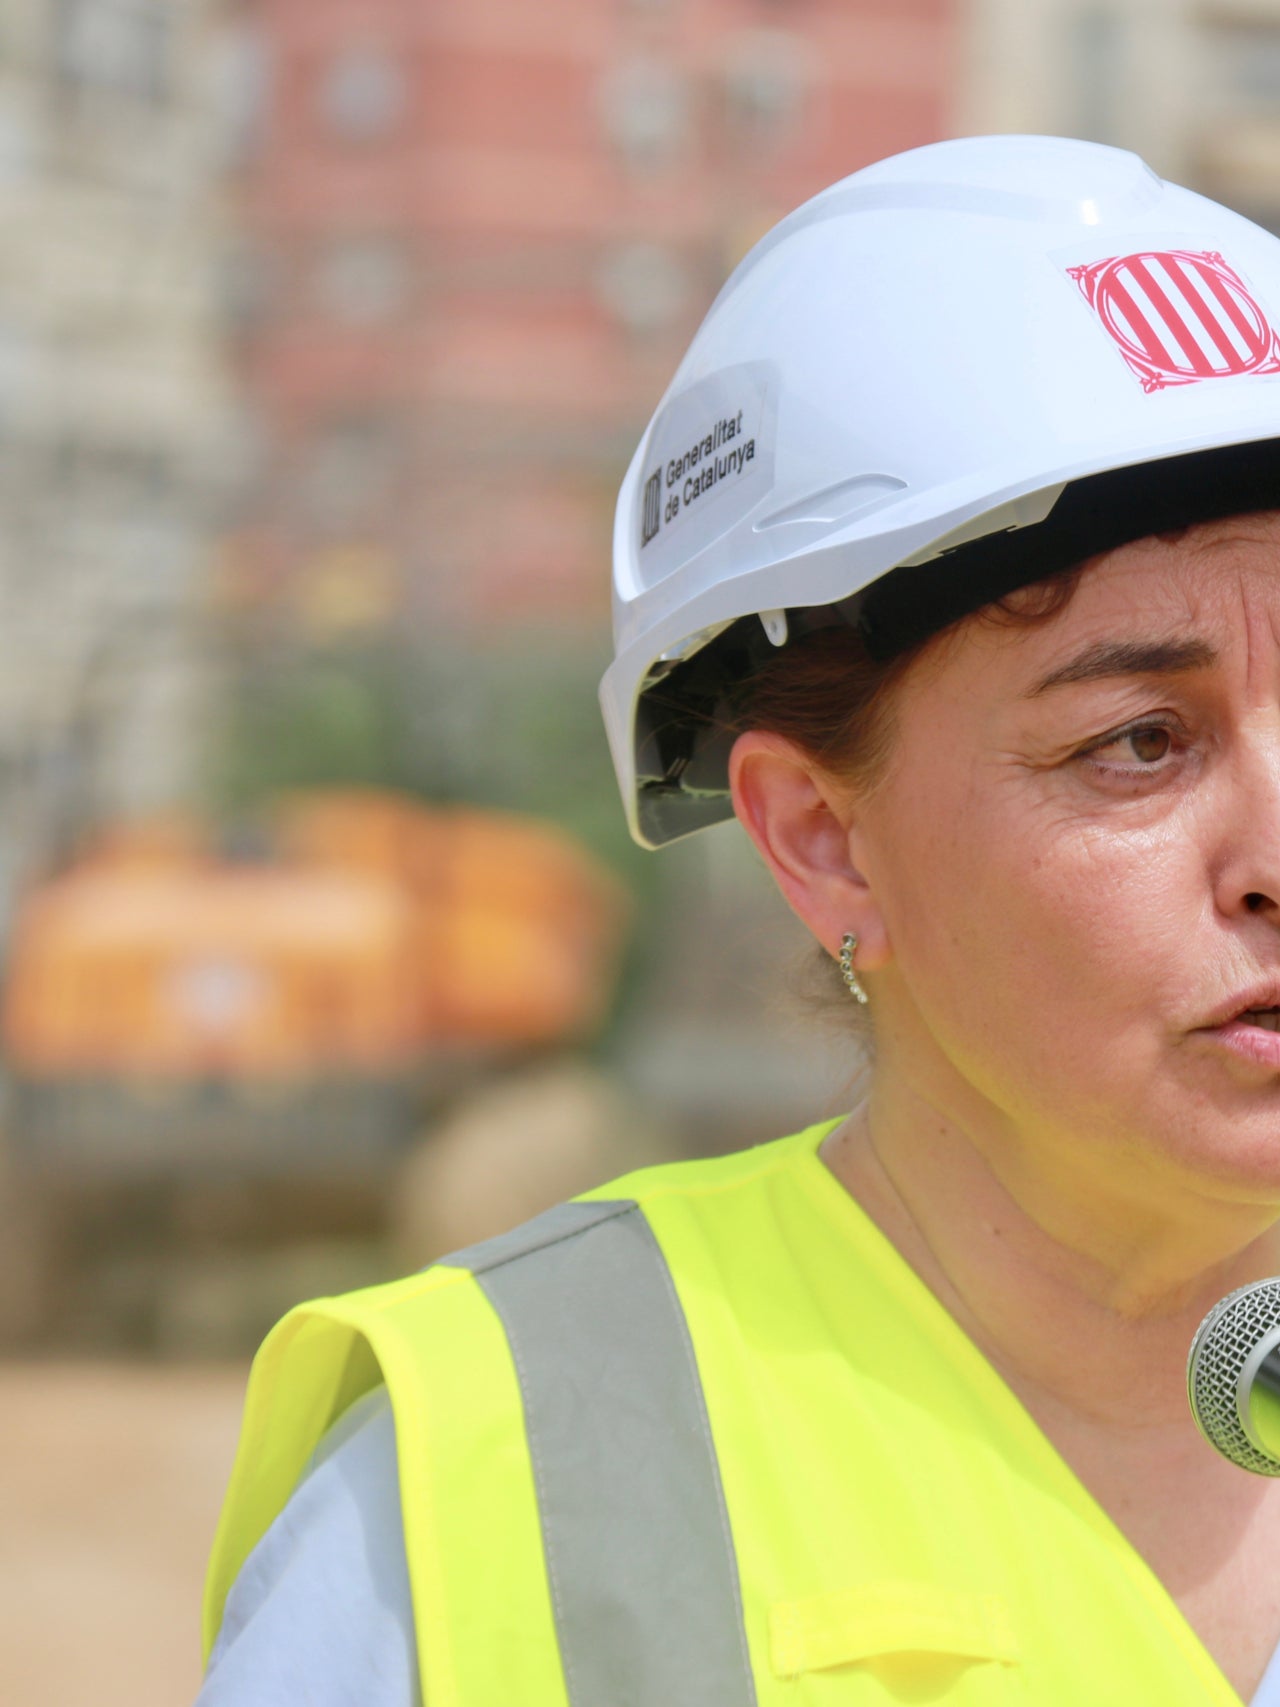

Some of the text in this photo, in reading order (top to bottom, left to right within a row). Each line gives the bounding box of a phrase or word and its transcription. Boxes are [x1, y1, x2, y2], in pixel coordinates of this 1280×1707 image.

[664, 438, 755, 524] de Catalunya
[666, 409, 743, 488] Generalitat
